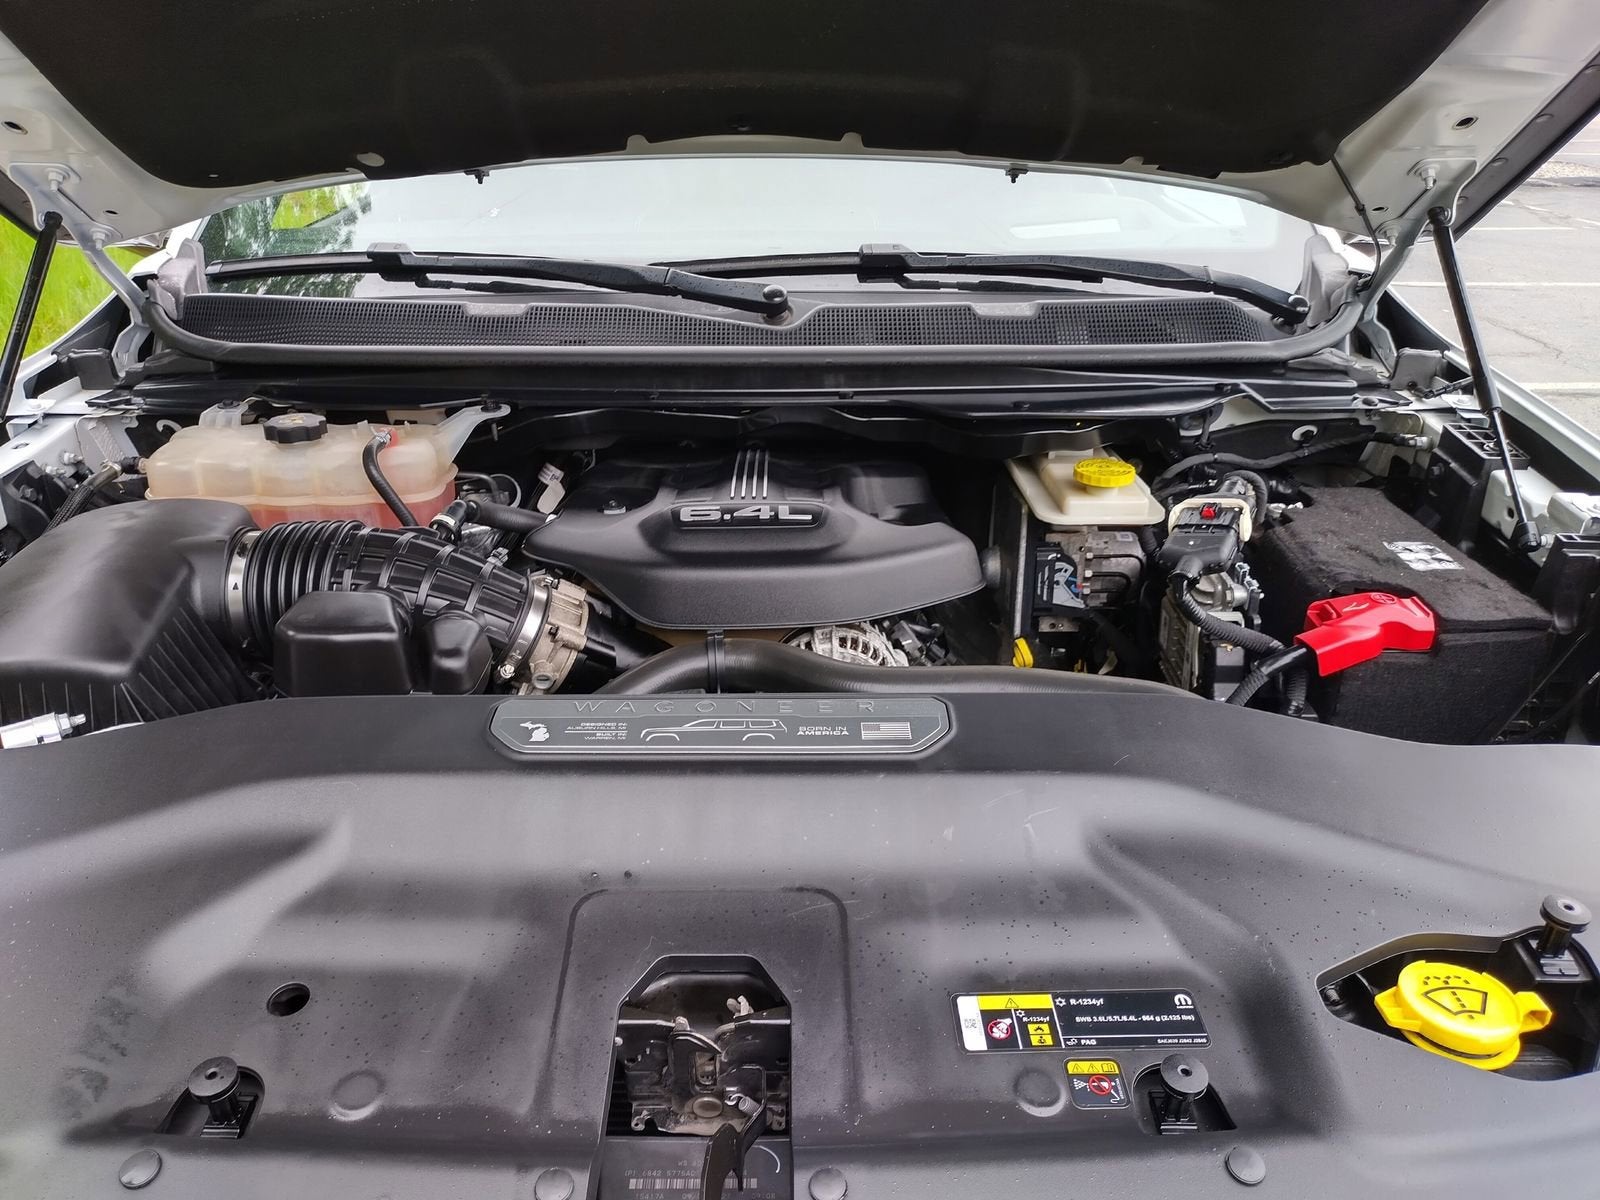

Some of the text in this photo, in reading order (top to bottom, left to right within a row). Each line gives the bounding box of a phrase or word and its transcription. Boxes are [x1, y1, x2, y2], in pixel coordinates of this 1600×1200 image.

[679, 505, 813, 522] 6.4L
[574, 700, 875, 713] WAGONEER
[1070, 998, 1104, 1007] R-1234yf
